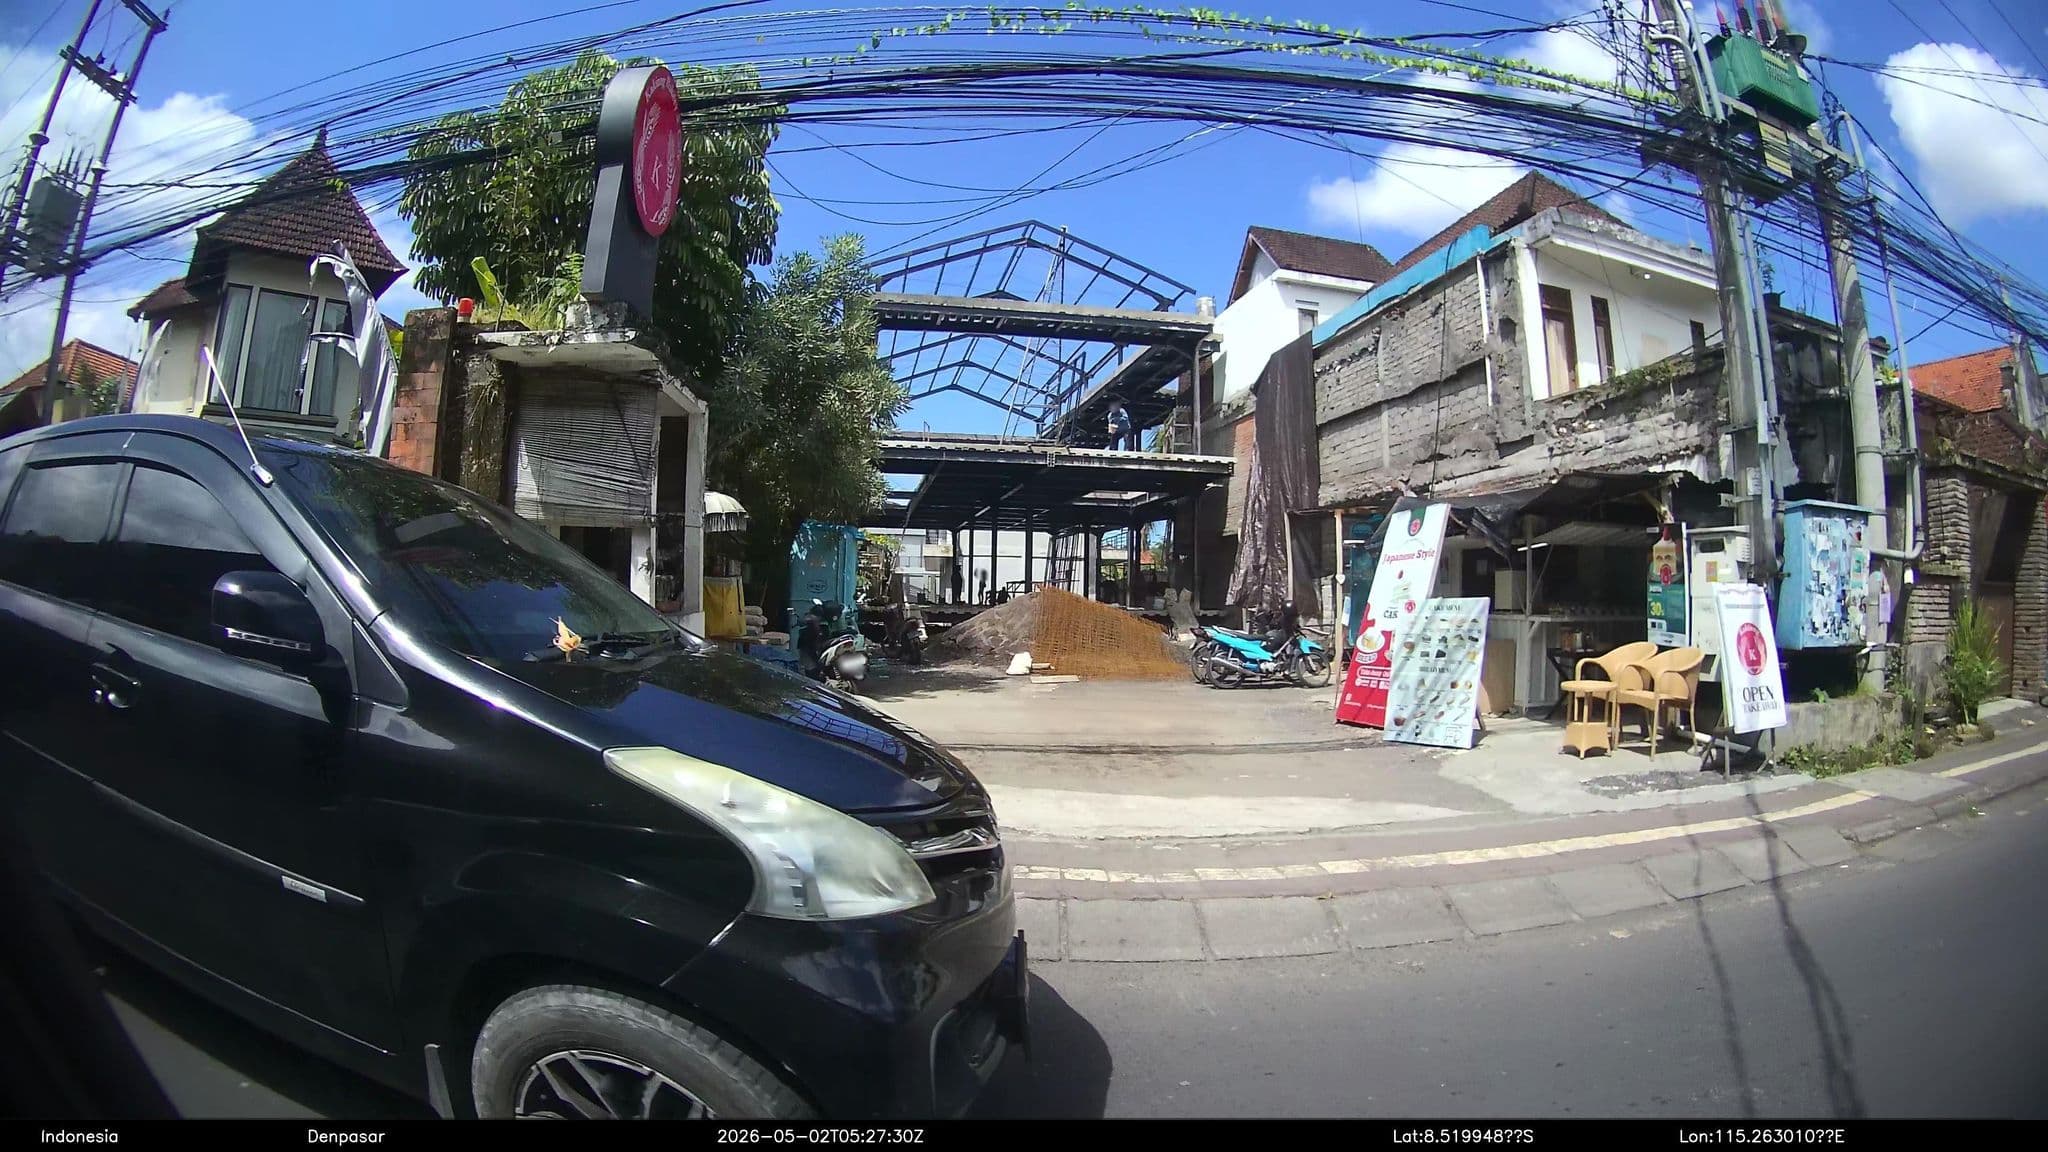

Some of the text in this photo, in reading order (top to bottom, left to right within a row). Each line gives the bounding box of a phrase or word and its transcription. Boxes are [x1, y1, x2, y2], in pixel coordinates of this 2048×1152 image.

[651, 155, 663, 191] K
[1416, 549, 1436, 560] Style
[1748, 648, 1757, 661] K
[1742, 685, 1775, 703] OPEN
